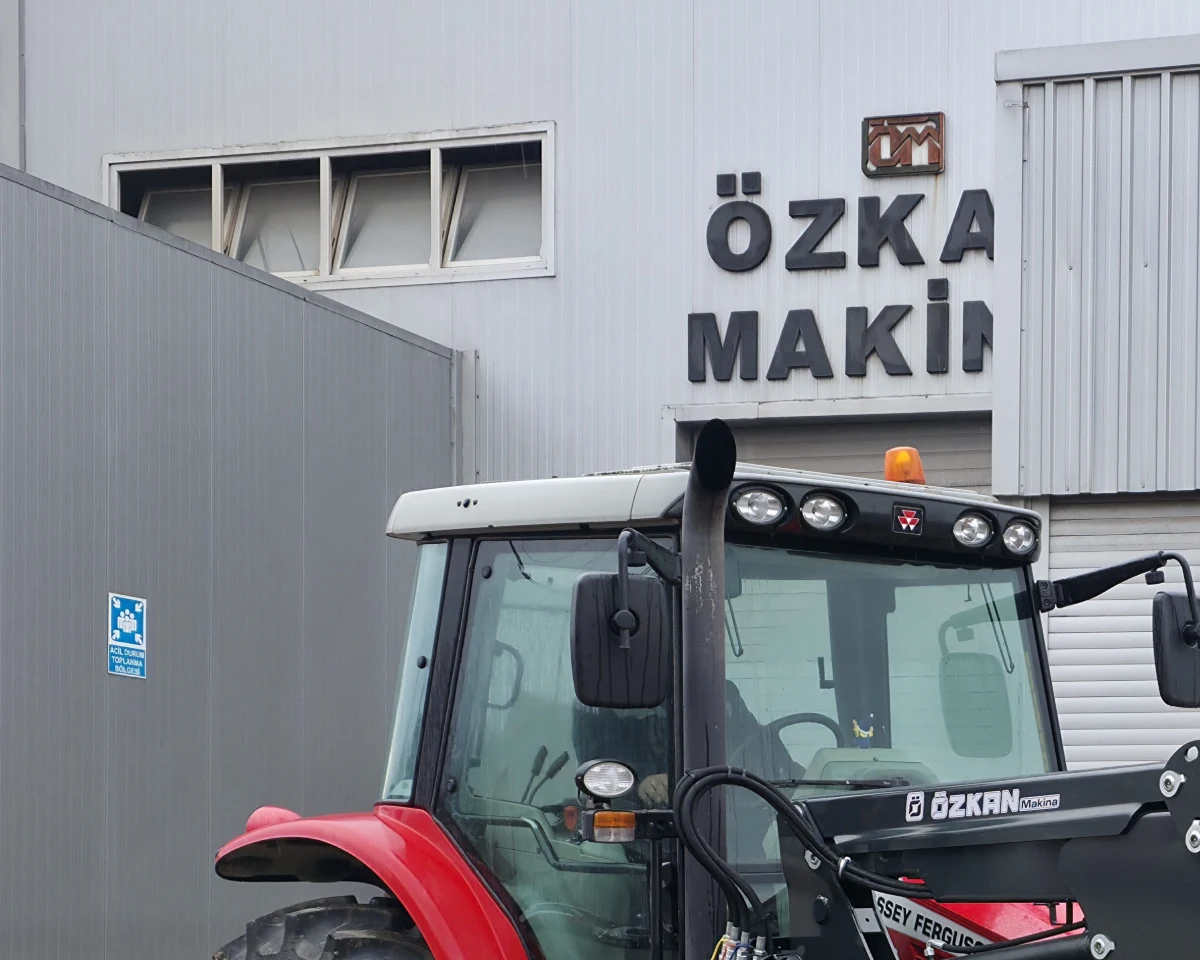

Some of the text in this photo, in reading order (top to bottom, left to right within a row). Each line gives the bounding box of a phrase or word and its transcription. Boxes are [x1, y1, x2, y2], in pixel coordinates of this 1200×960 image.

[110, 646, 123, 656] ACİL
[931, 788, 1020, 820] ÖZKAN
[1021, 797, 1058, 809] Makina
[877, 896, 912, 926] SSEY
